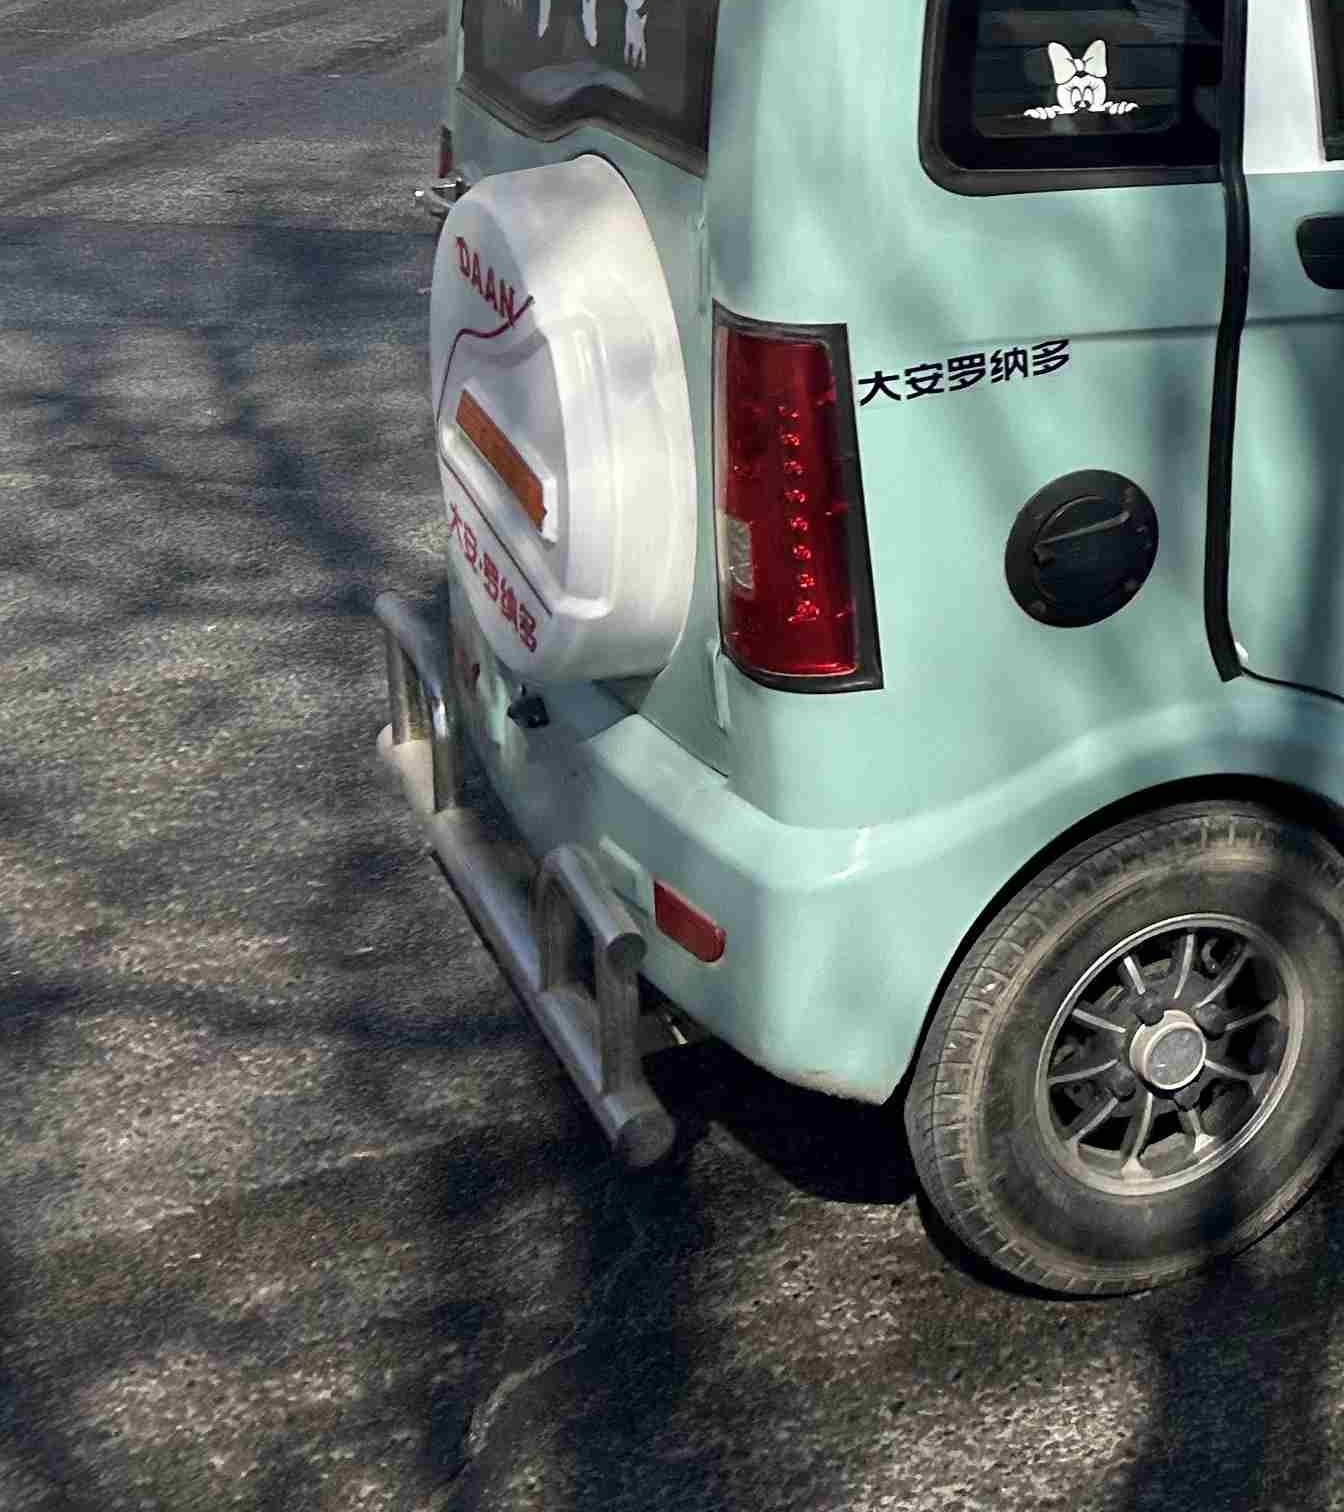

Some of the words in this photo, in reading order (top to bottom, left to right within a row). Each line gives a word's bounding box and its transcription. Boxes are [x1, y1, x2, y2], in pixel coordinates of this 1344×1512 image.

[455, 235, 518, 327] DAAN
[858, 338, 1071, 406] 大安罗纳多
